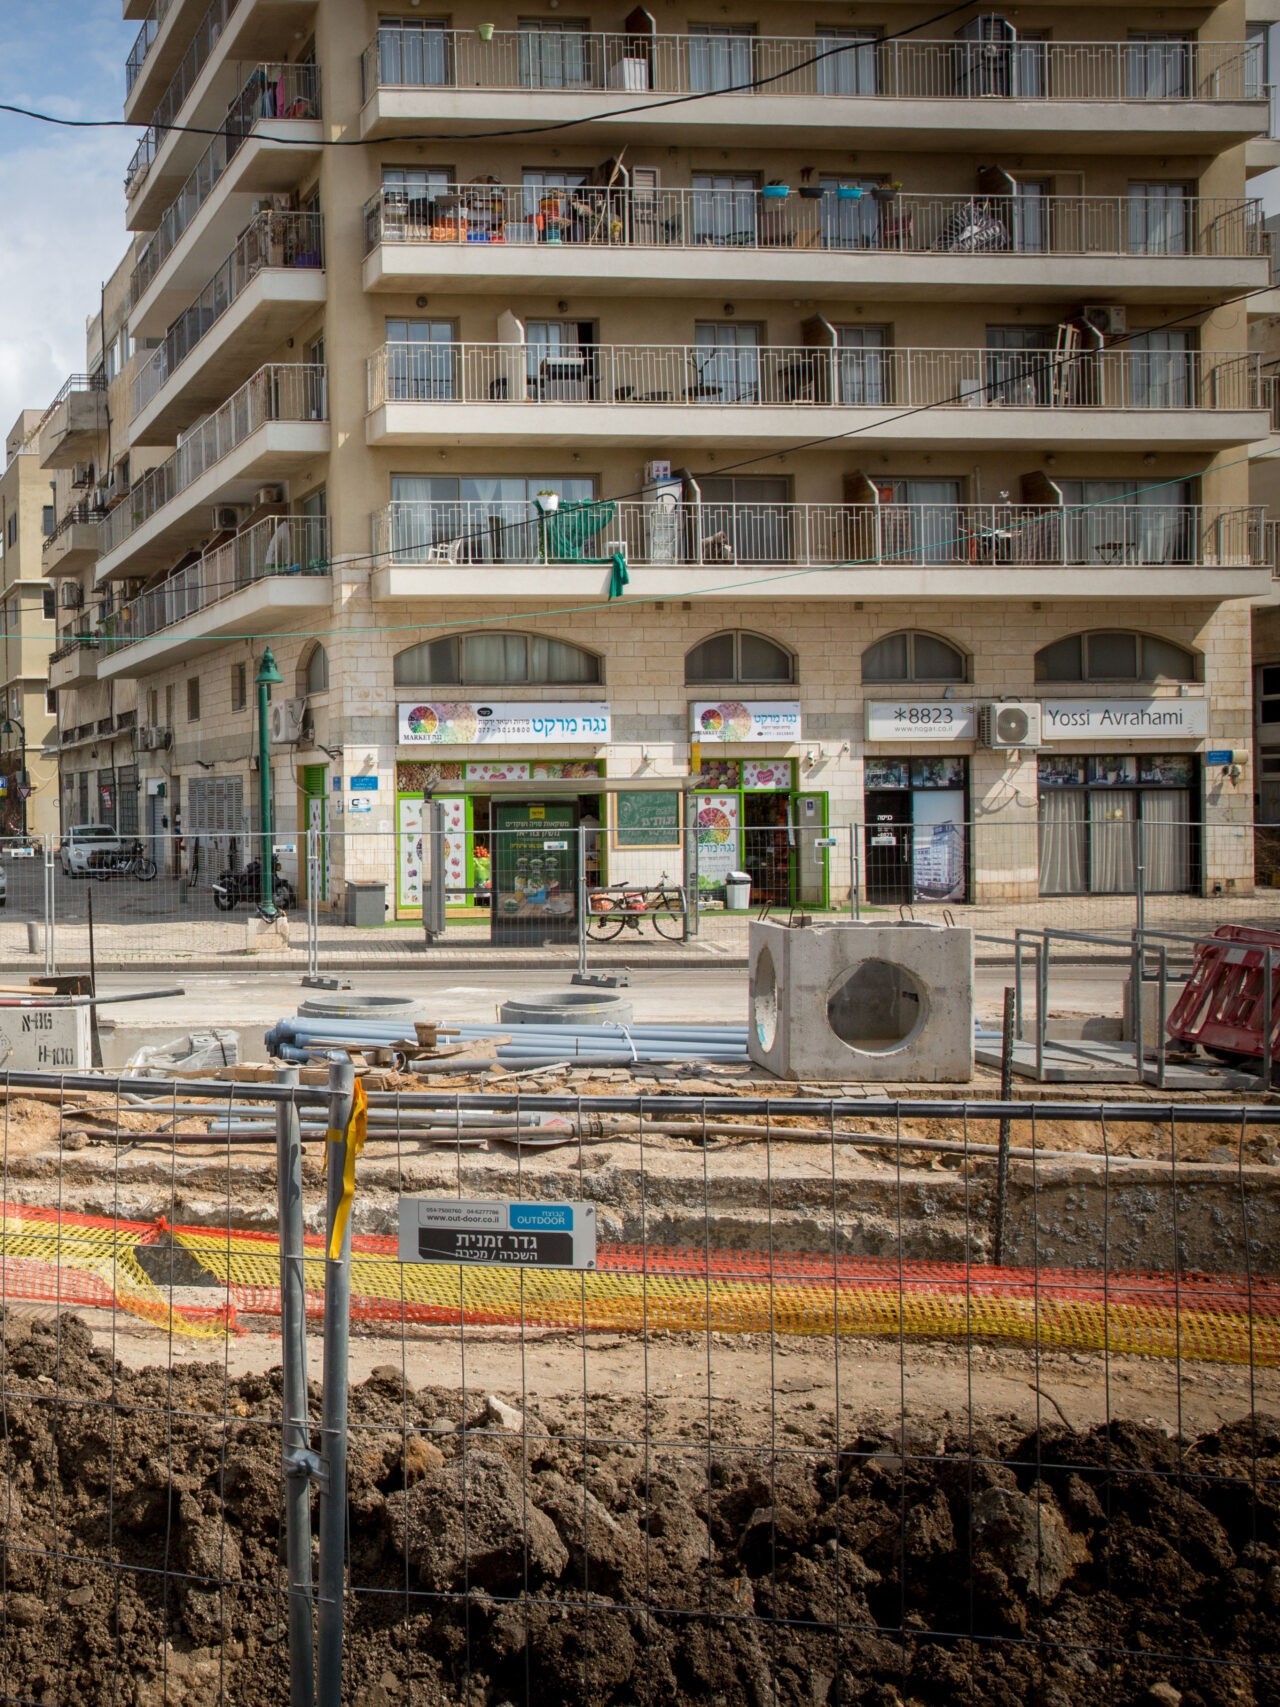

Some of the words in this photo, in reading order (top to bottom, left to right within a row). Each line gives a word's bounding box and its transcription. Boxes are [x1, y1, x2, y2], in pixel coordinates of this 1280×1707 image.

[1048, 709, 1090, 726] Yossi
[1100, 708, 1183, 726] Avrahami
[426, 1214, 500, 1223] www.out-door.co.il
[517, 1216, 566, 1225] OUTDOOR
[456, 1233, 503, 1248] זמנית
[508, 1235, 538, 1249] גדר
[499, 1250, 538, 1260] השכרה
